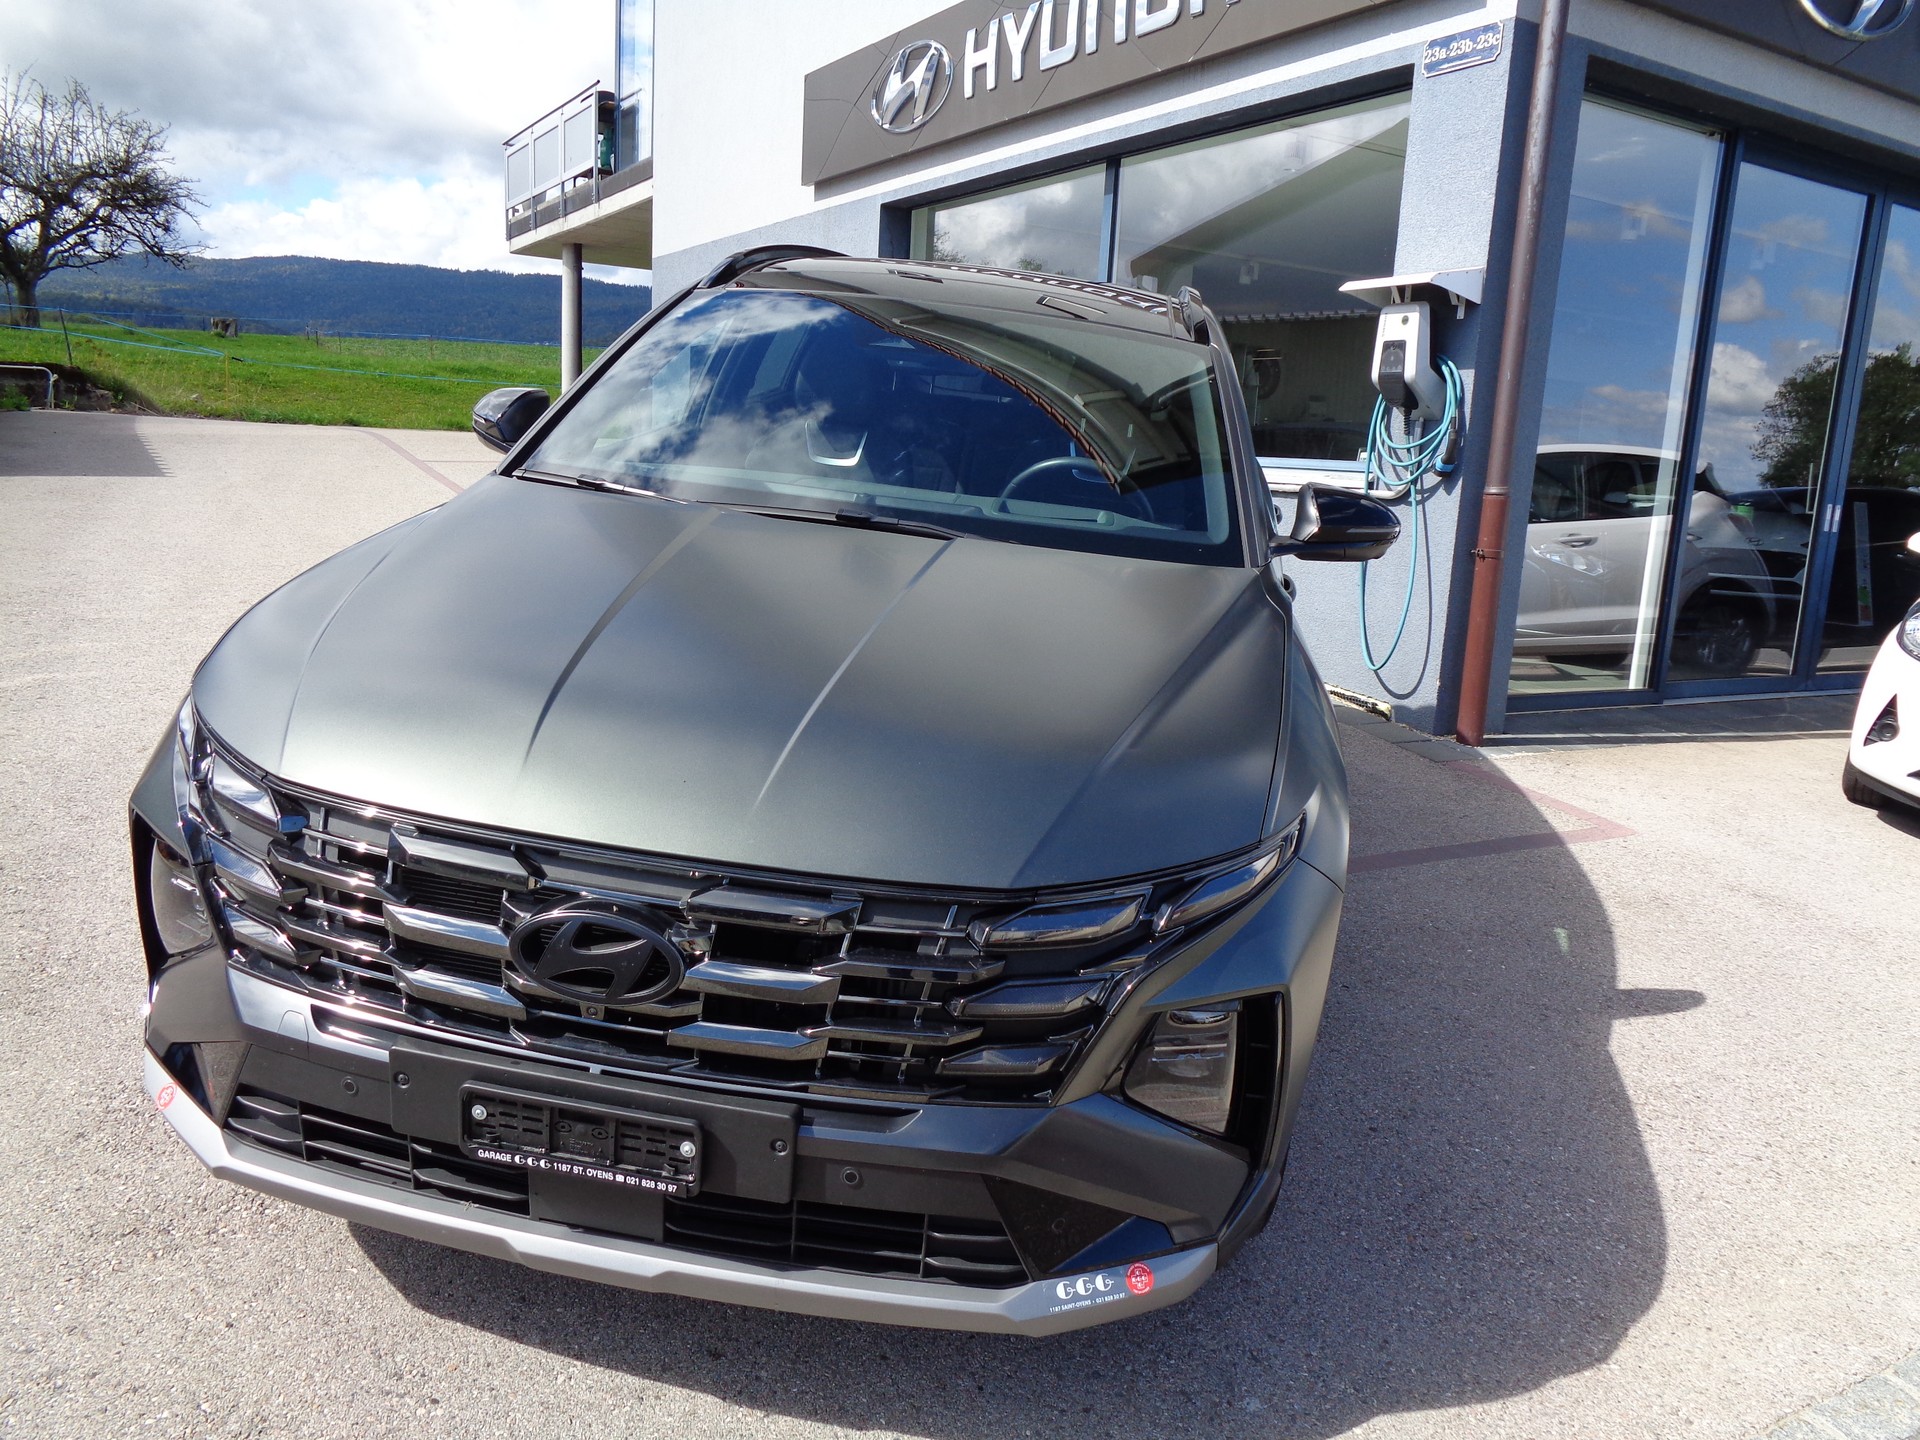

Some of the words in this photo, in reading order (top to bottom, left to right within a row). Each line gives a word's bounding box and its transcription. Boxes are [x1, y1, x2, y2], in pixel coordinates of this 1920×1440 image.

[963, 0, 1241, 99] HYUN
[477, 1149, 512, 1162] GARAGE
[553, 1162, 571, 1173] 1187
[572, 1165, 585, 1175] ST.
[586, 1168, 614, 1180] OYENS
[626, 1176, 639, 1185] 021
[656, 1181, 667, 1191] 30
[667, 1184, 678, 1193] 97
